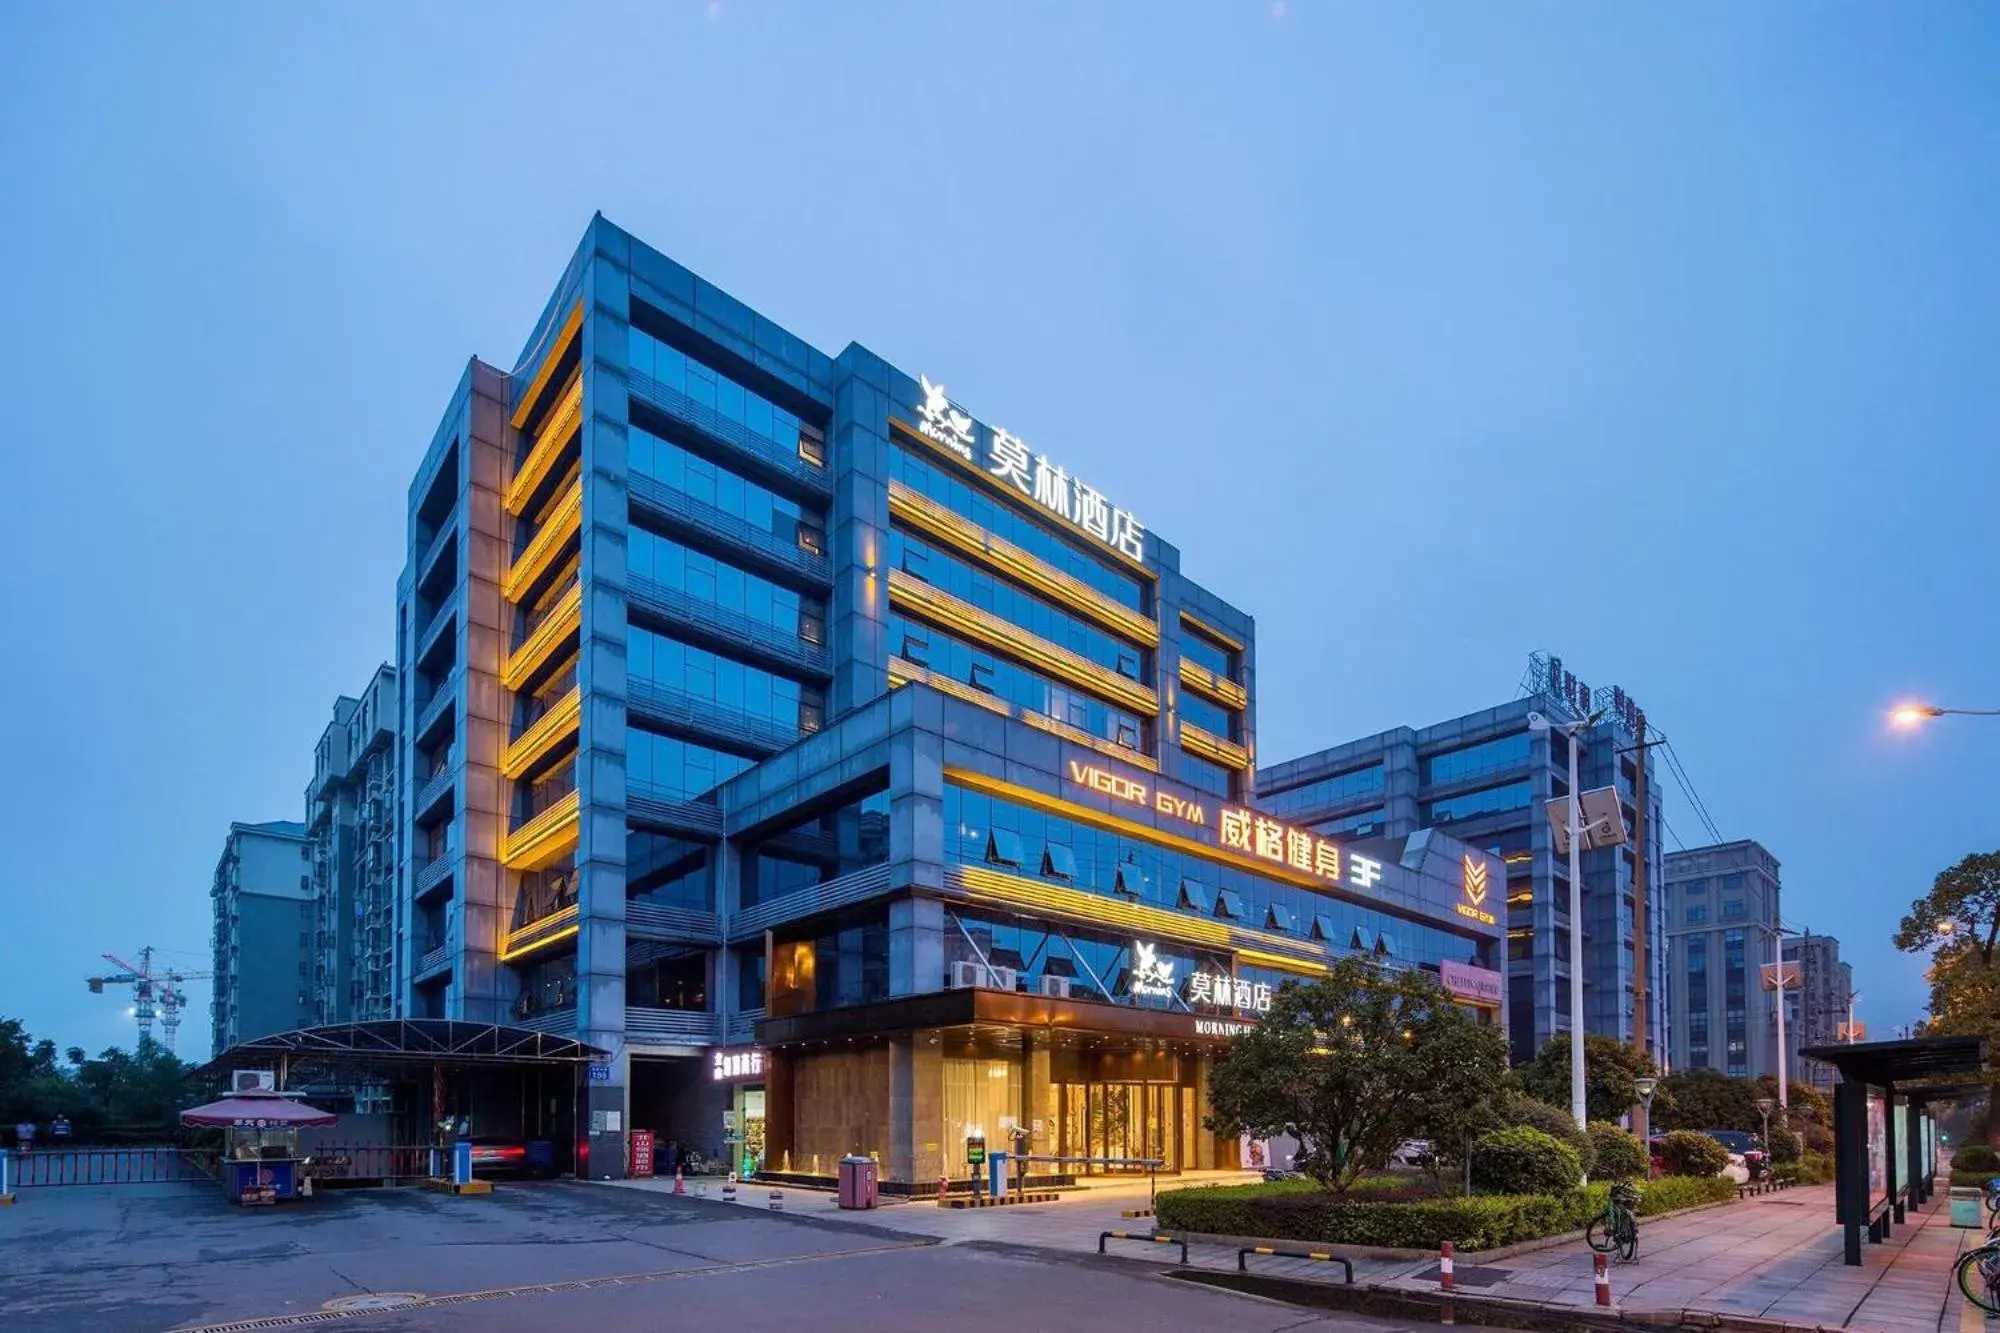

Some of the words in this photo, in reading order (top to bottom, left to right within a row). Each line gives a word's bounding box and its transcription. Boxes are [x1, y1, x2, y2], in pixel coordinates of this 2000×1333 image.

[988, 424, 1146, 563] 莫林酒店
[1070, 760, 1147, 805] VIGOR
[1156, 791, 1205, 825] GYM
[1220, 806, 1340, 880] 威格健身
[1190, 971, 1272, 1012] 莫林酒店
[1195, 1019, 1242, 1036] MORNING
